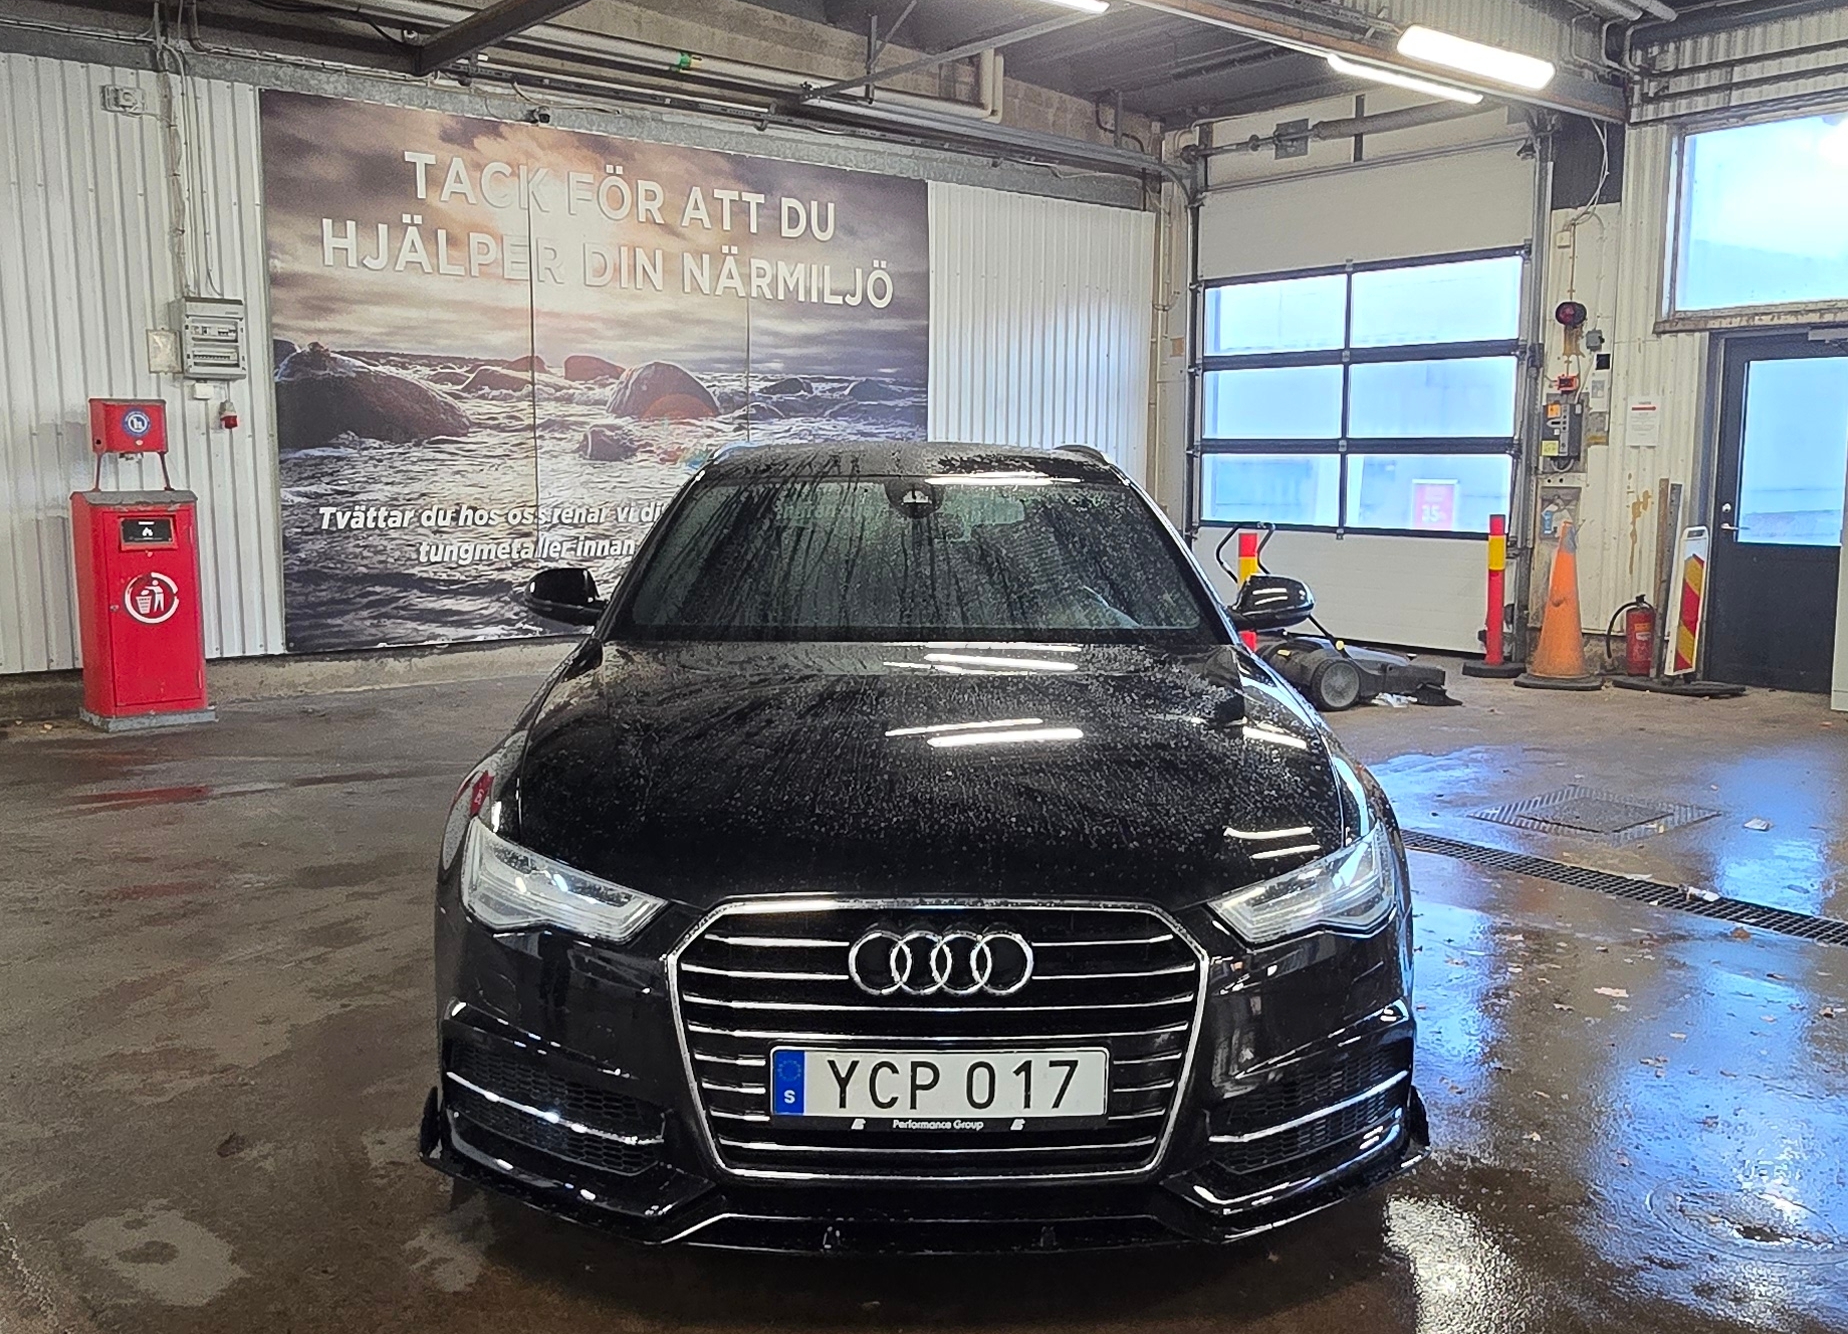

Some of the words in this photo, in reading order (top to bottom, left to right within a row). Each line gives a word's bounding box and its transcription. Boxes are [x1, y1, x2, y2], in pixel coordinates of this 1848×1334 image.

[404, 151, 550, 213] TACK
[567, 164, 665, 224] FÖR
[681, 186, 765, 234] ATT
[780, 196, 835, 242] DU
[322, 213, 565, 284] HJÄLPER
[582, 241, 664, 292] DIN
[683, 244, 894, 309] NÄRMILJÖ
[319, 505, 415, 530] Tvättar
[421, 505, 451, 527] du
[458, 504, 500, 527] hos
[507, 507, 549, 526] oss
[552, 507, 608, 524] renar
[616, 503, 635, 523] vi
[419, 533, 572, 565] tungmetaller
[576, 536, 635, 557] innan
[783, 1090, 796, 1104] S
[827, 1059, 941, 1110] YCP
[965, 1059, 1080, 1110] 017
[892, 1119, 952, 1130] Performance
[953, 1119, 984, 1131] Group
